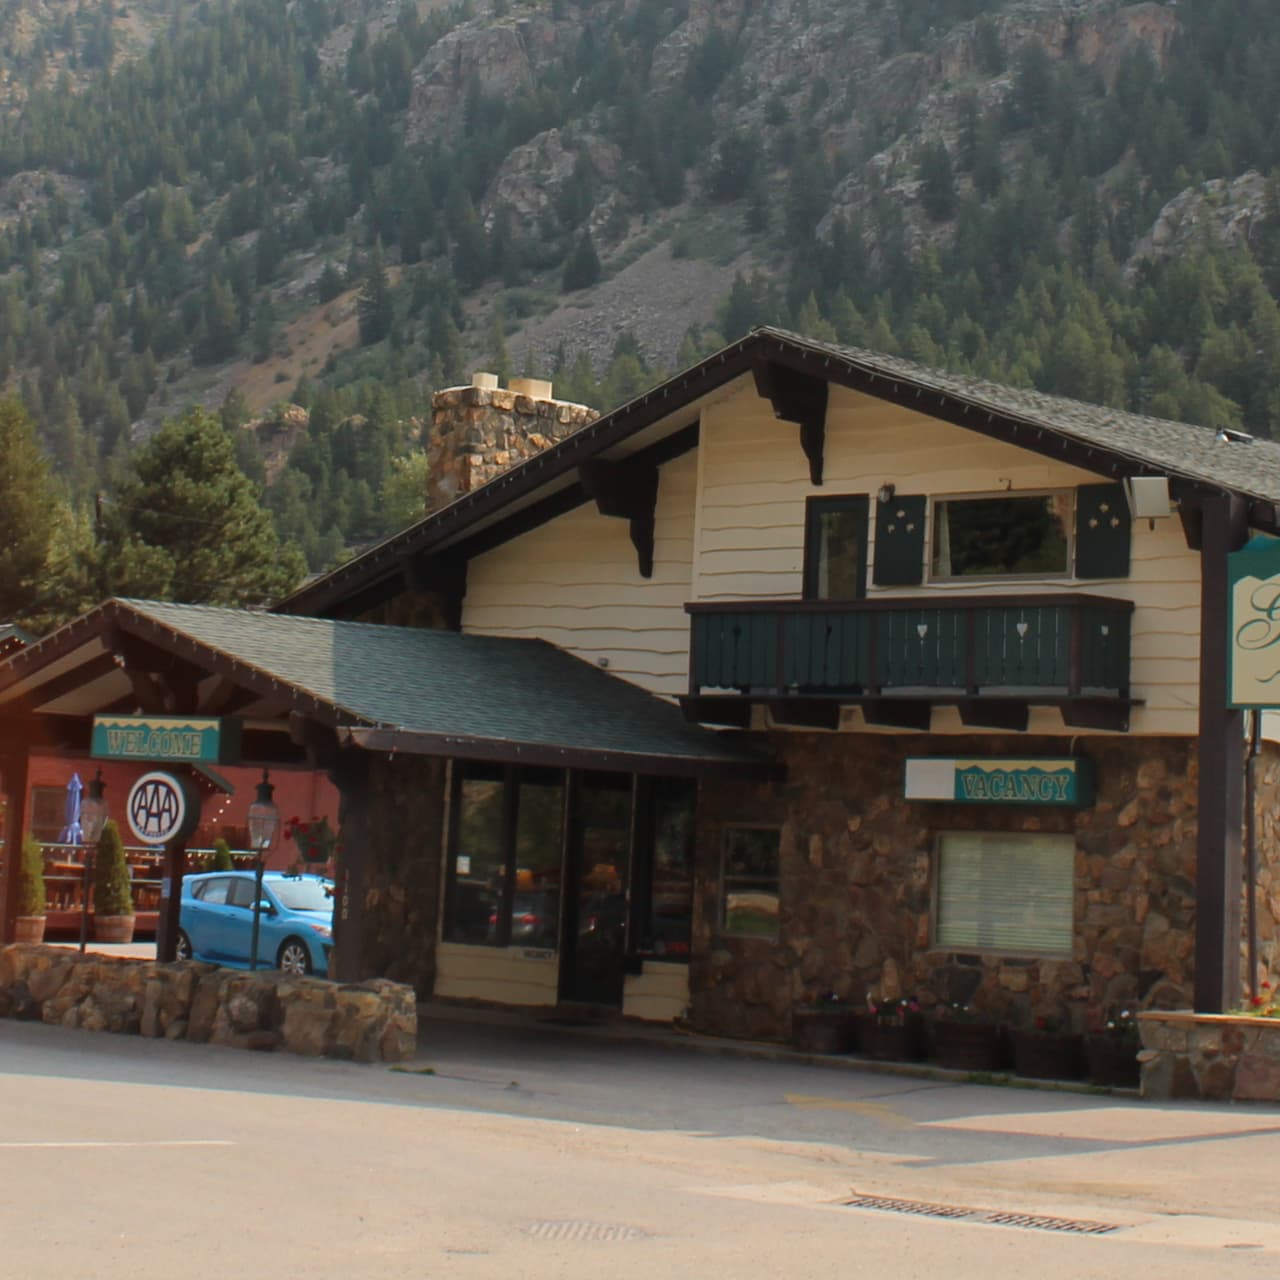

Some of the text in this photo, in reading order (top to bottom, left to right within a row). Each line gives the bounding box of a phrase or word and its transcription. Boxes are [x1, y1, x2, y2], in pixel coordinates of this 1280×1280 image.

[107, 729, 202, 757] WELCOME
[962, 773, 1069, 801] VACANCY
[135, 782, 174, 833] AAA
